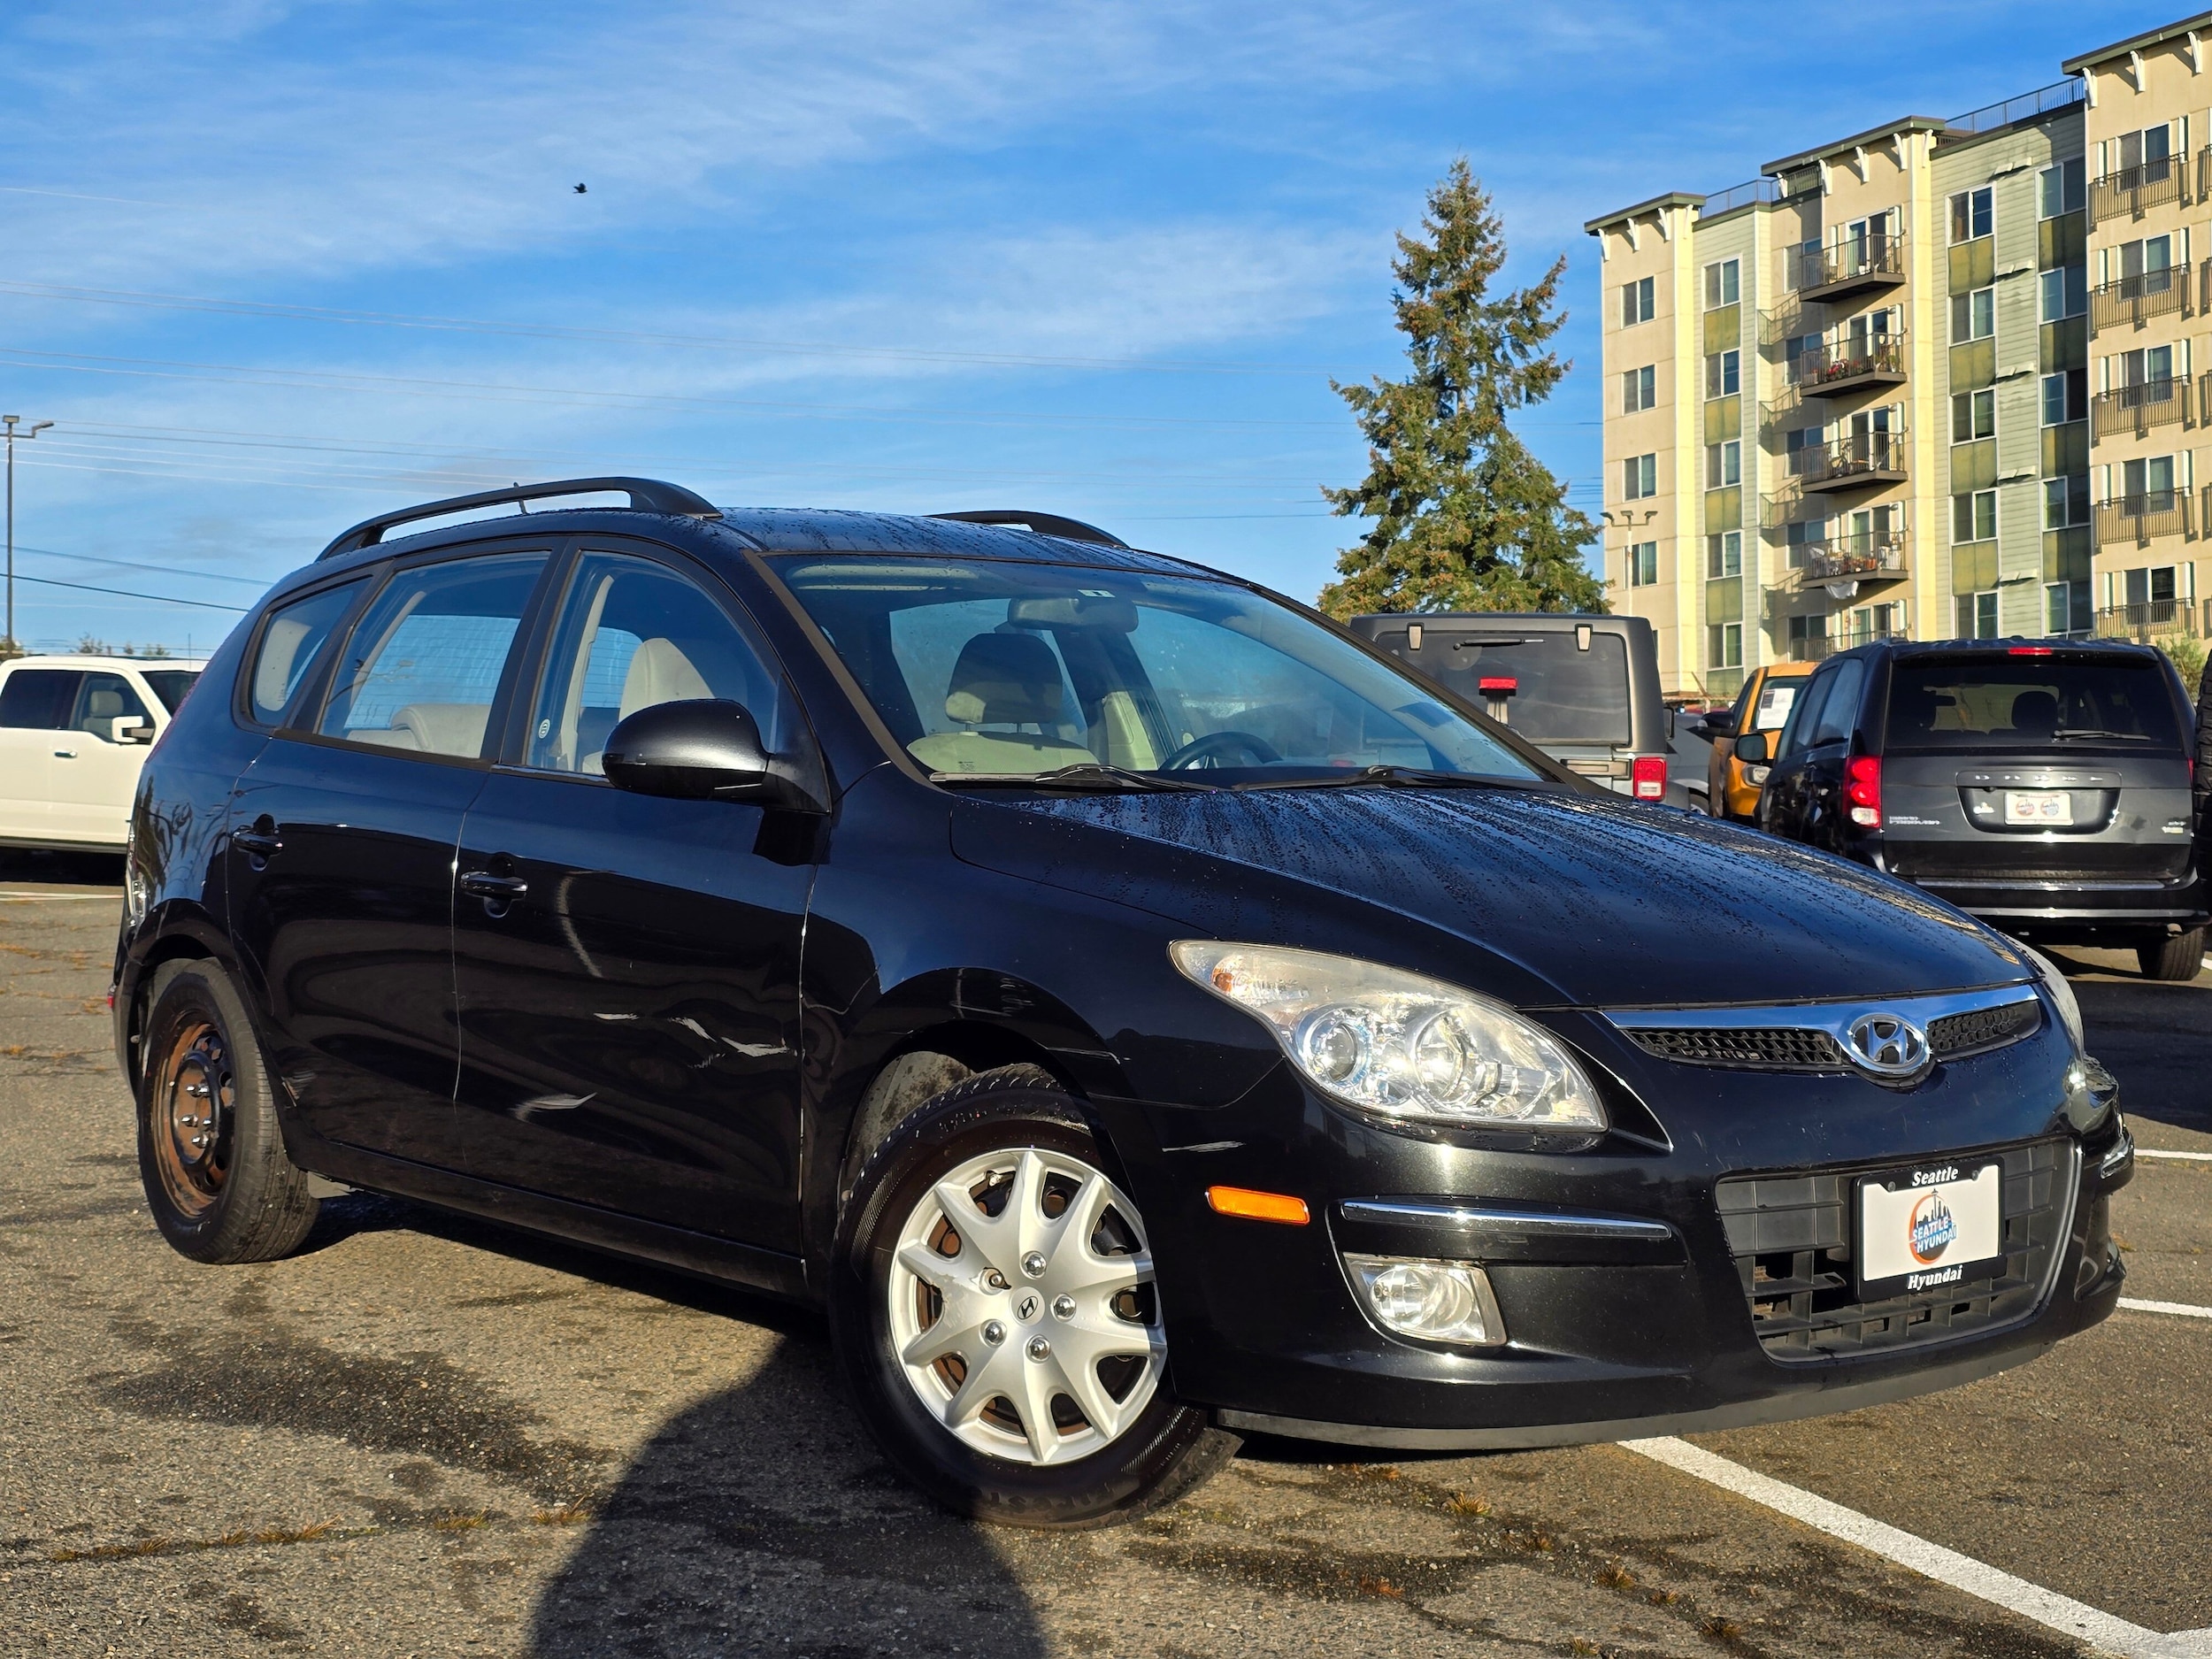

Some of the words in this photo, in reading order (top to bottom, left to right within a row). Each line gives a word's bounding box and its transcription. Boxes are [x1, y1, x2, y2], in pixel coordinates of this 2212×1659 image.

[1912, 1166, 1959, 1187] Seattle
[1912, 1218, 1949, 1240] SEATTLE
[1916, 1224, 1957, 1254] HYUNDAI
[1907, 1264, 1963, 1290] Hyundai
